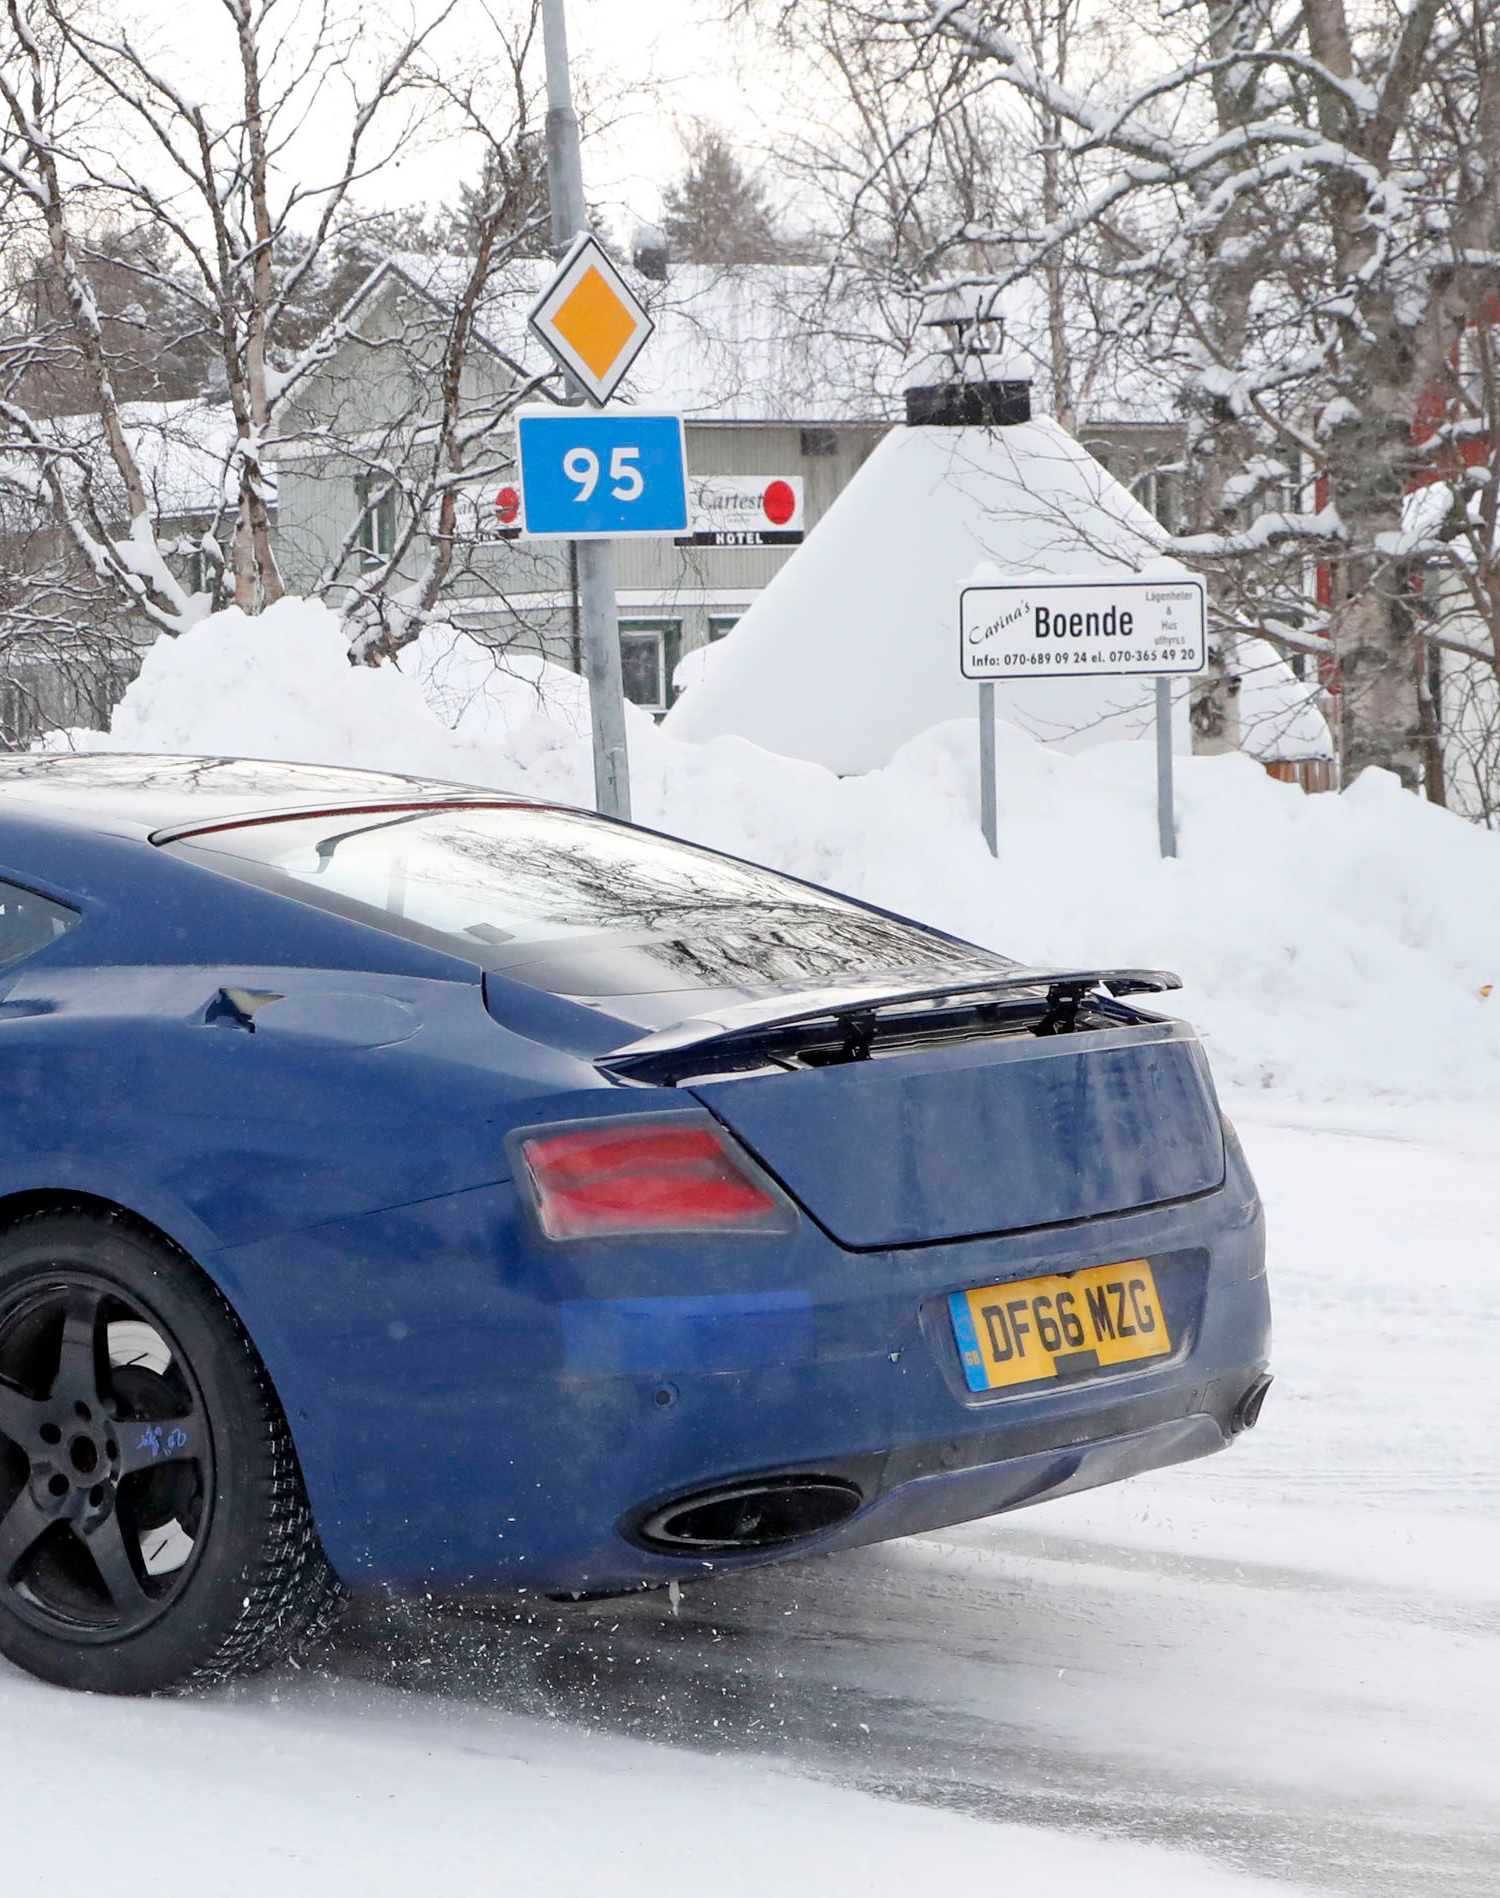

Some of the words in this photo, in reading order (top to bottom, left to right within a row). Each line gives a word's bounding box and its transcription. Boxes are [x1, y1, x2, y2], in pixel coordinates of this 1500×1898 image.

[563, 447, 644, 502] 95
[715, 532, 763, 545] HOTEL
[969, 599, 1031, 645] Carina's
[1035, 605, 1133, 638] Boende
[972, 655, 1000, 667] Info:
[1004, 653, 1051, 666] 070-689
[1055, 652, 1069, 664] 09
[1073, 652, 1087, 664] 24
[1091, 650, 1105, 663] el.
[1109, 650, 1157, 662] 070-365
[1162, 649, 1176, 661] 49
[1181, 648, 1195, 660] 20
[981, 1291, 1085, 1363] DF66
[1085, 1279, 1155, 1342] MZG
[965, 1351, 981, 1366] GB
